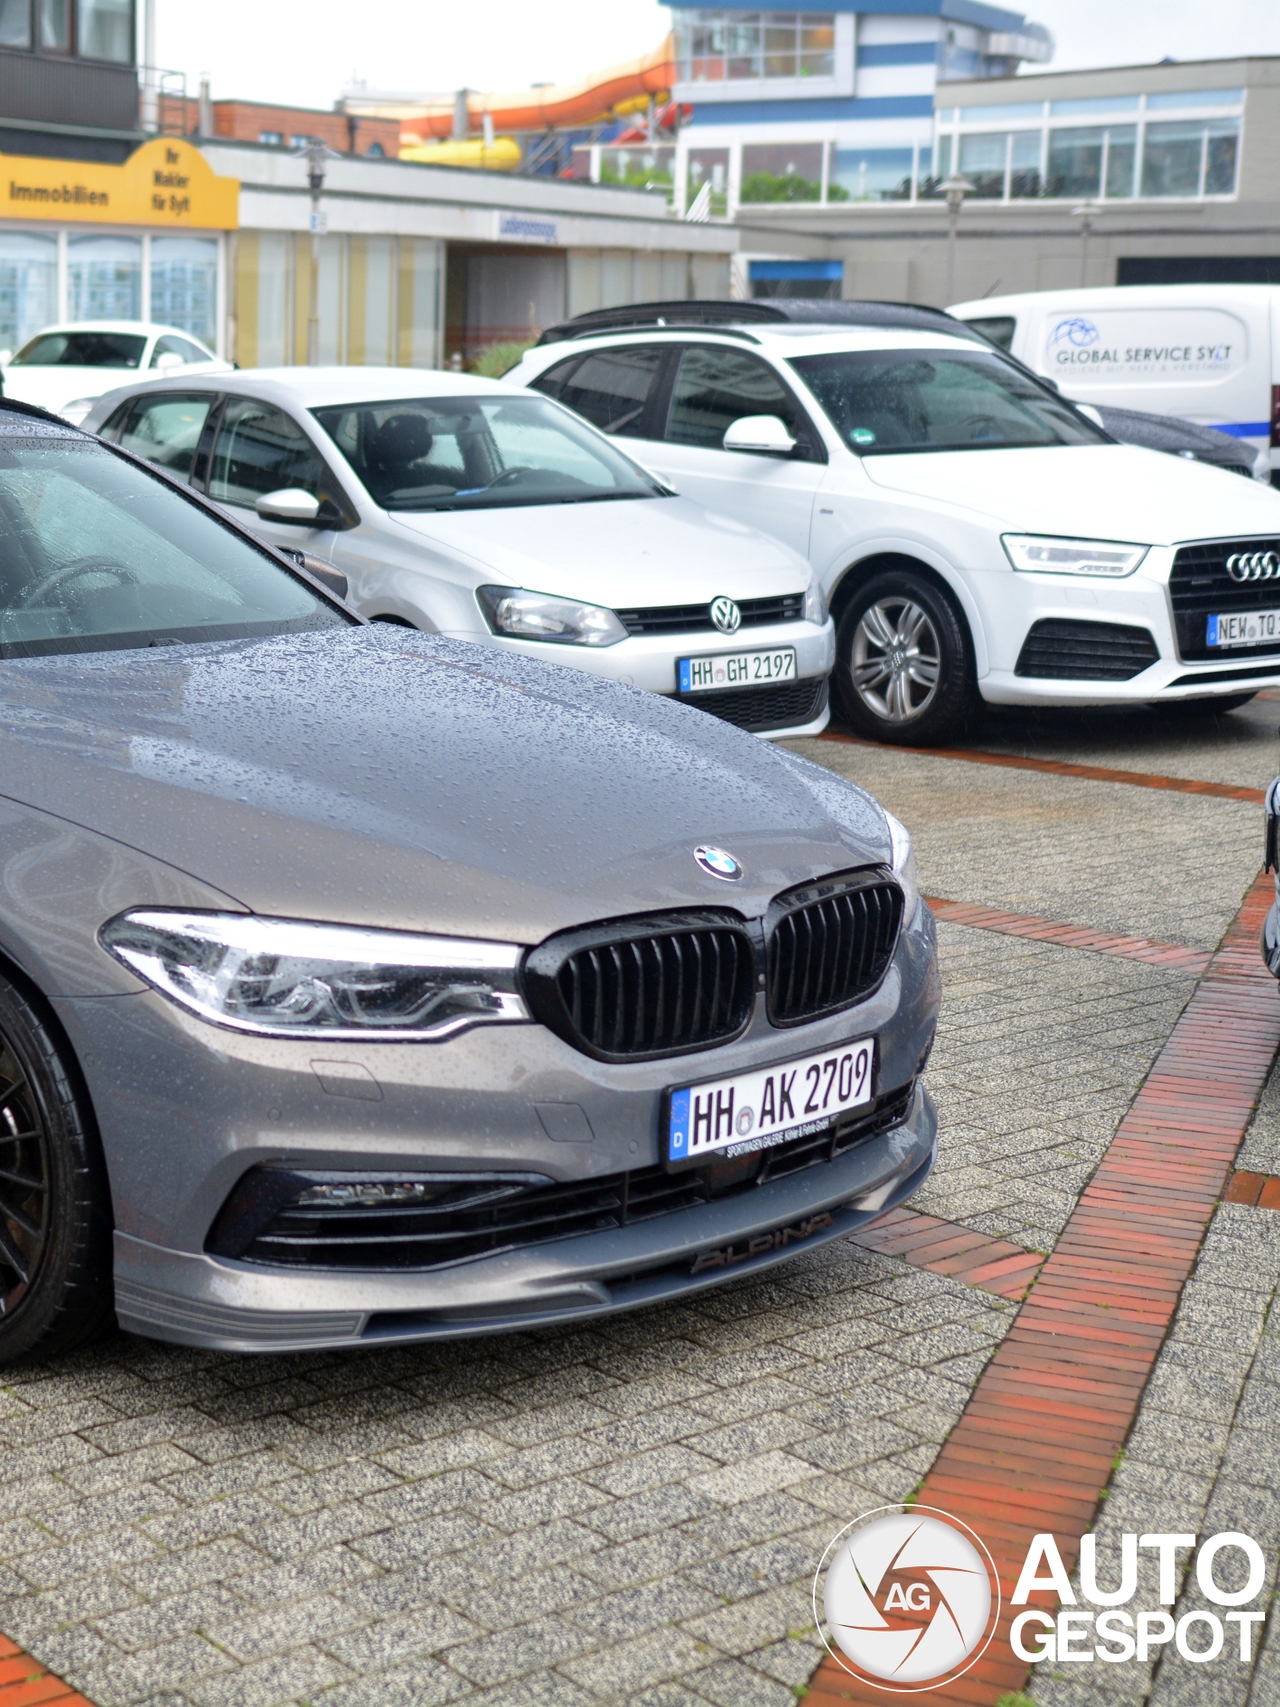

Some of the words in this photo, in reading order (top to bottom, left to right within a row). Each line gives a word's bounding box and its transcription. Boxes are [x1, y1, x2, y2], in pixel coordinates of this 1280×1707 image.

[165, 148, 180, 164] Ihr
[154, 170, 190, 189] Makler
[9, 181, 109, 206] Immobilien
[170, 195, 190, 217] Sylt
[1056, 349, 1120, 365] GLOBAL
[1125, 345, 1192, 363] SERVICE
[1197, 343, 1232, 362] SYLT
[1219, 616, 1247, 641] NEW
[1259, 614, 1276, 637] TQ
[692, 661, 714, 686] HH
[727, 657, 749, 683] GH
[754, 653, 794, 680] 2197
[673, 1131, 683, 1149] D
[693, 1086, 735, 1147] HH
[759, 1069, 798, 1129] AK
[804, 1048, 869, 1116] 2709
[690, 1211, 834, 1275] ALPINA
